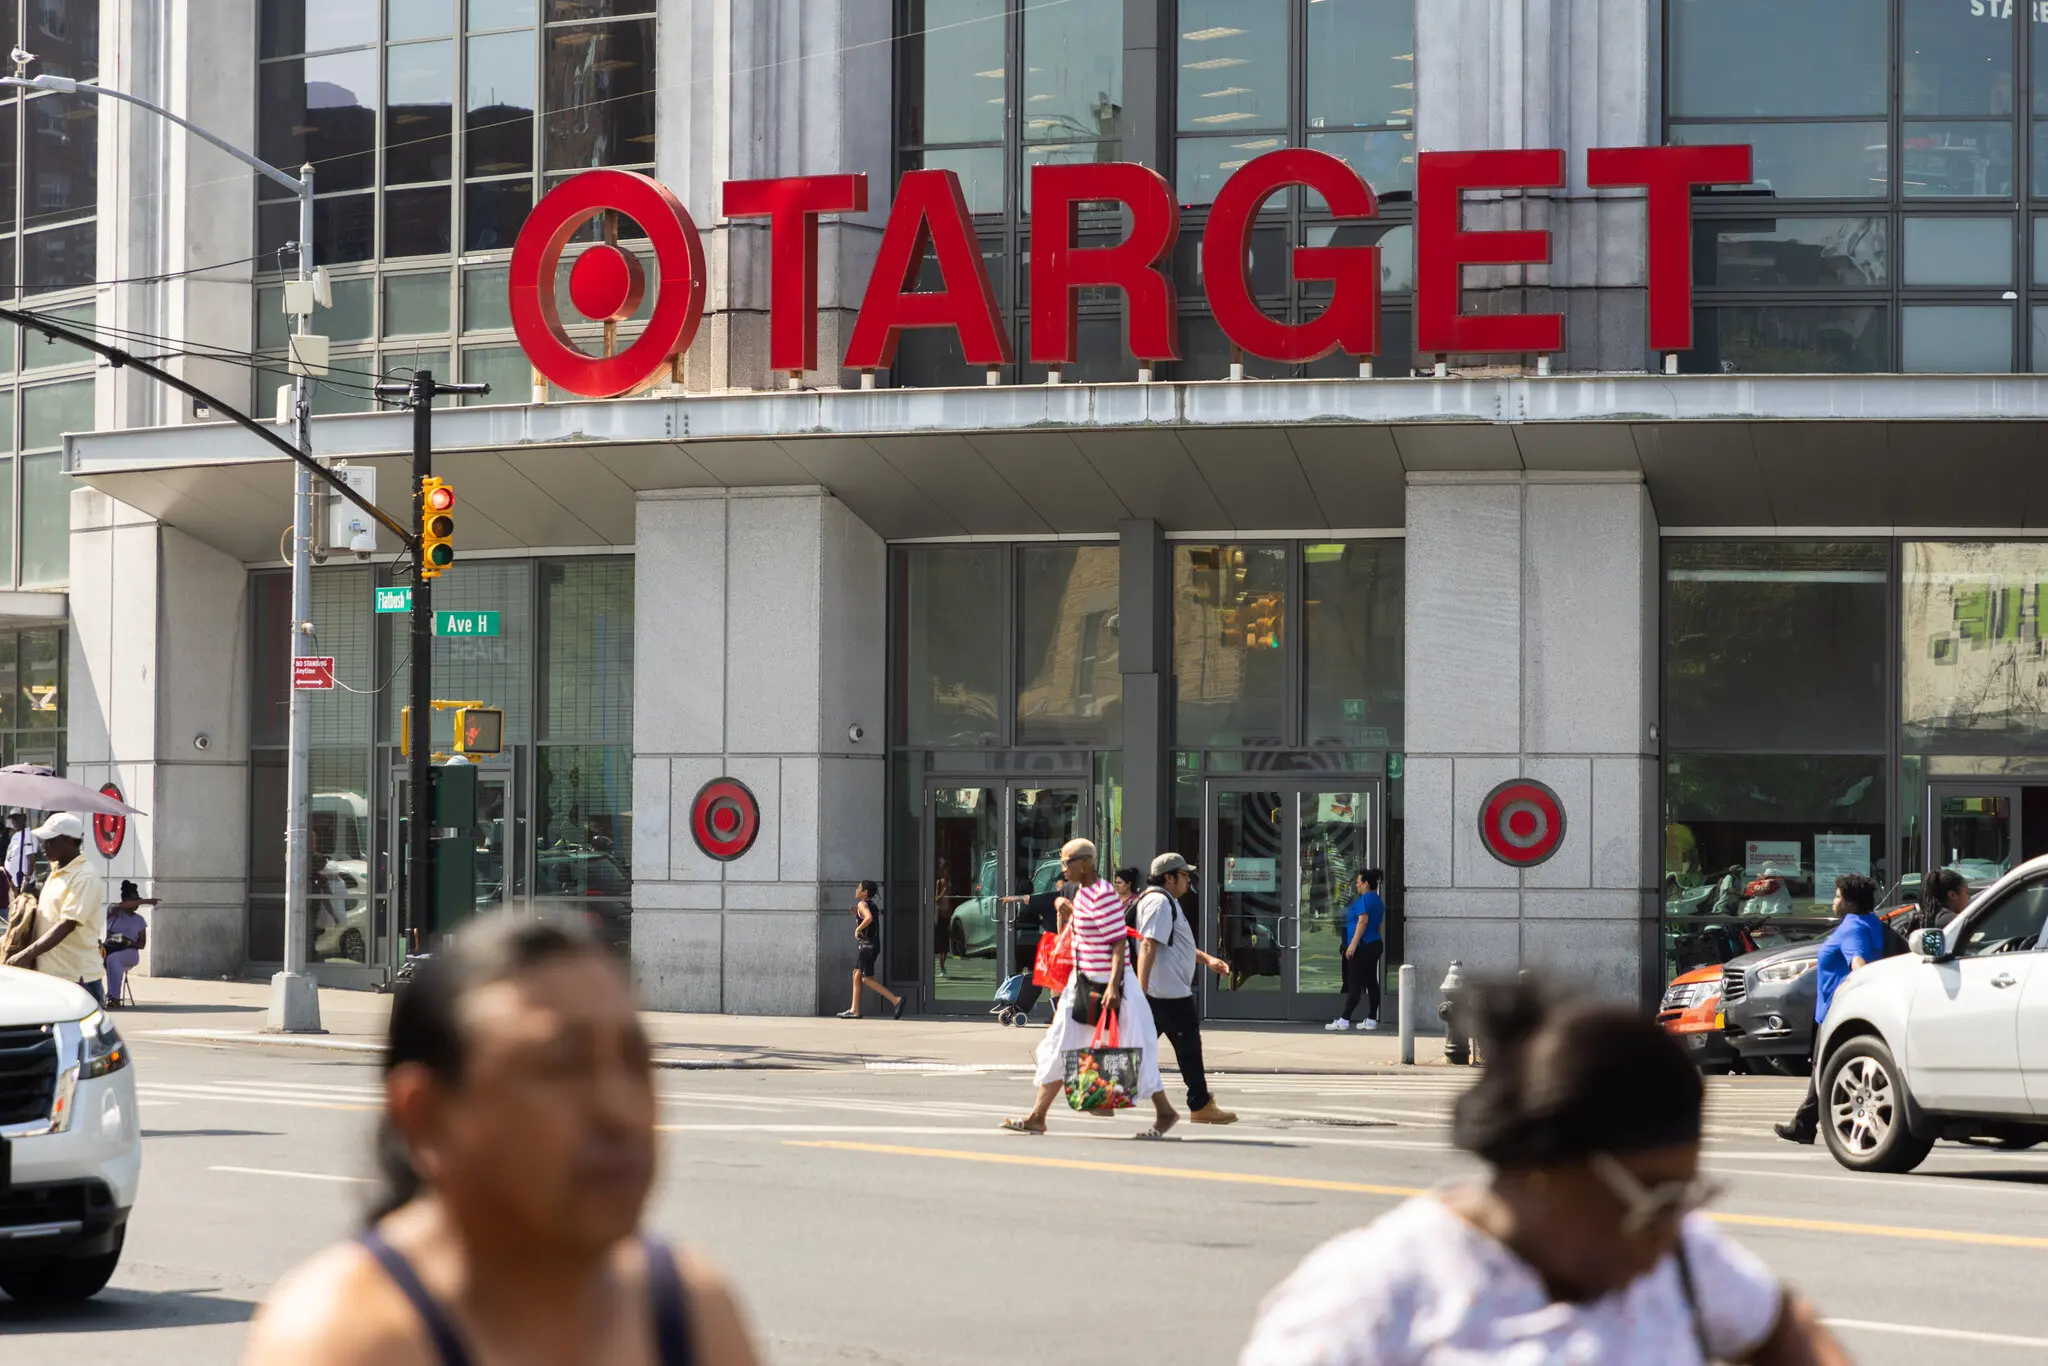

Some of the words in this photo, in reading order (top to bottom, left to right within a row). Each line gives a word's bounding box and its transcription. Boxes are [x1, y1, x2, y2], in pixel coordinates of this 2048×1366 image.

[722, 143, 1753, 372] TARGET
[377, 591, 405, 610] Flatbush
[447, 614, 473, 633] Ave
[478, 614, 488, 633] H
